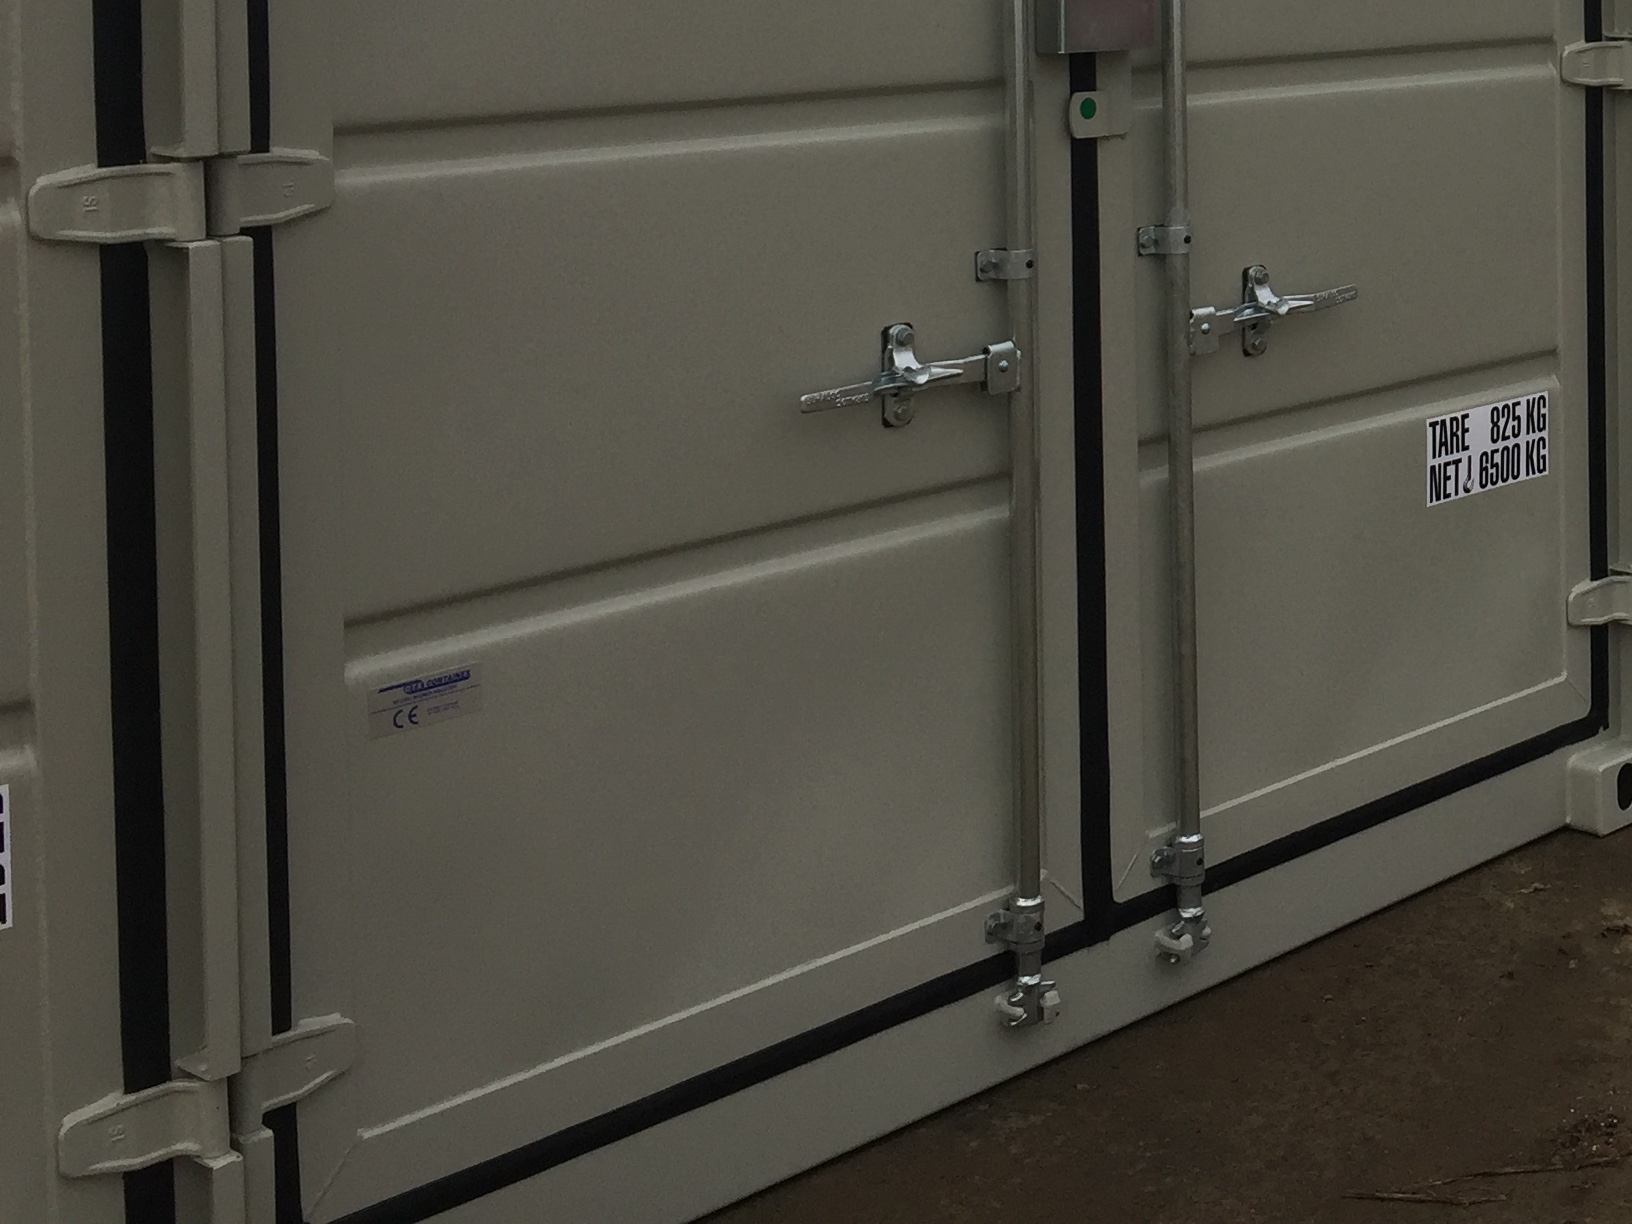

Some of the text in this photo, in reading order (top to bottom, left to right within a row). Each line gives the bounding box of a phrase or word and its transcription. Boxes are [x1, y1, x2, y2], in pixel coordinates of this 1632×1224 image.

[1429, 394, 1547, 459] TARE 825 KG
[1429, 436, 1547, 504] NET 6500 KG
[393, 705, 419, 728] CE
